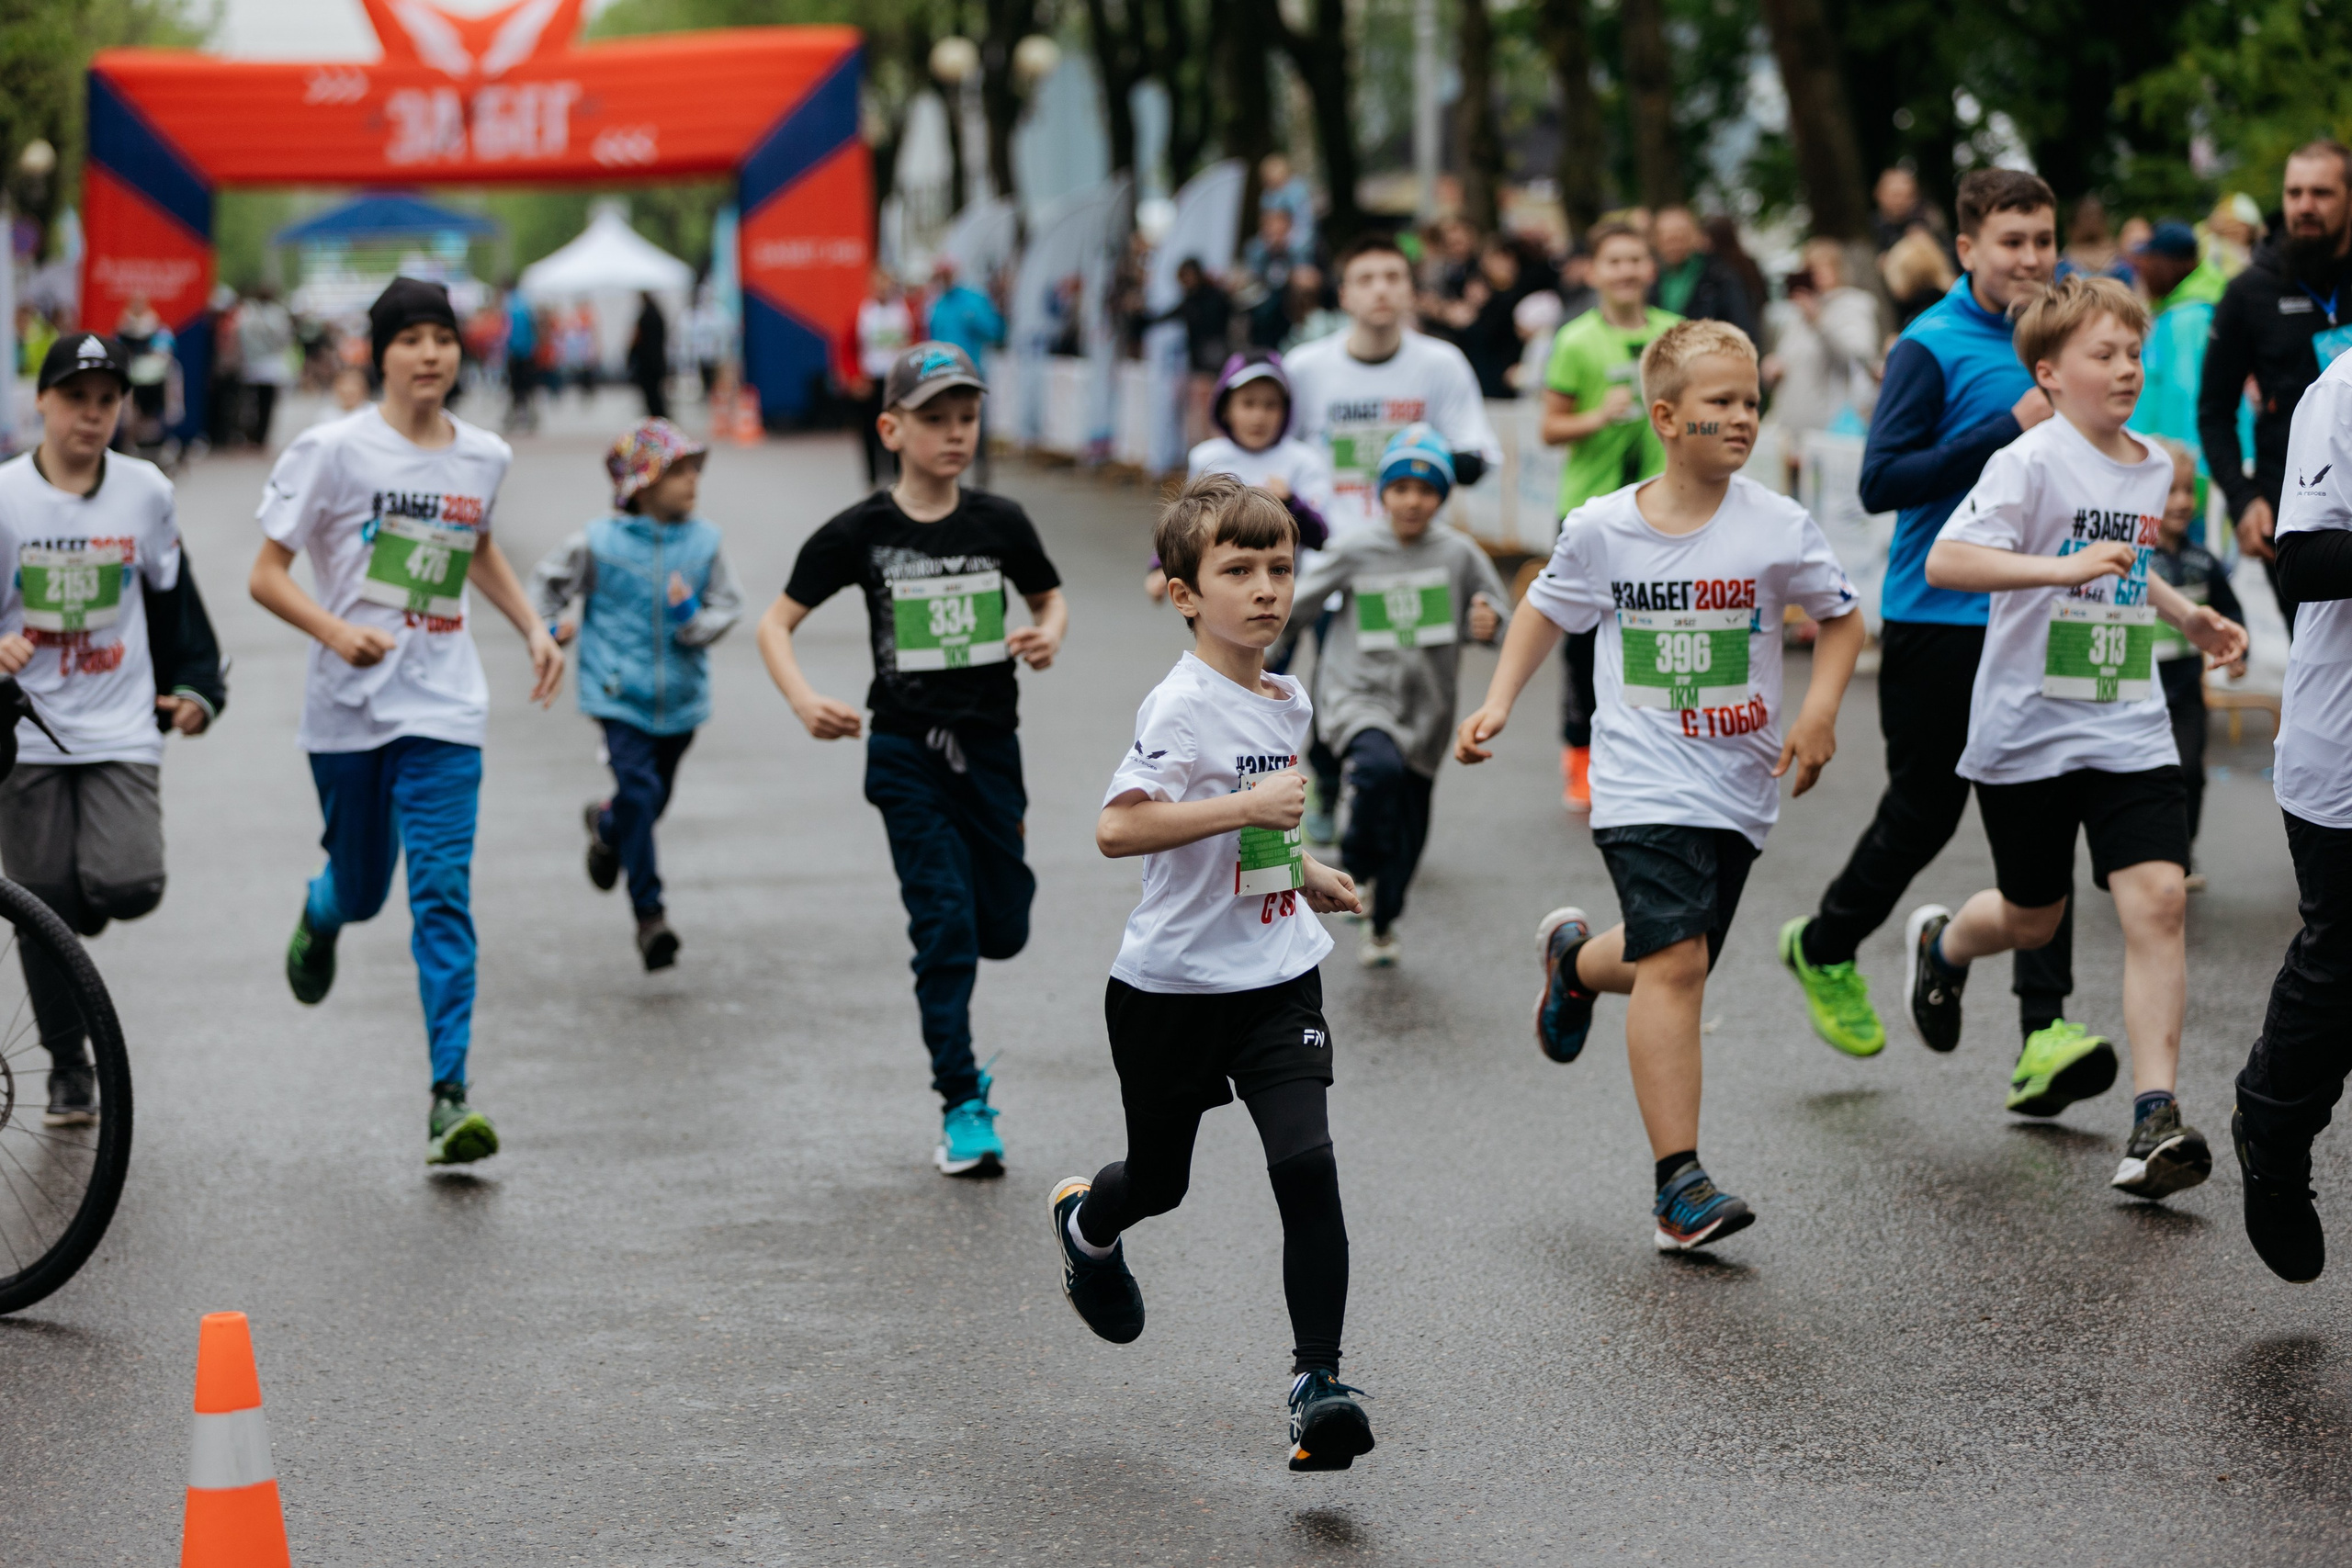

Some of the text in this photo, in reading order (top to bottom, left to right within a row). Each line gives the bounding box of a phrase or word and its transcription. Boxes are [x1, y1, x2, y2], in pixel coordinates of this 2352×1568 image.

[1611, 579, 1757, 612] #ЗАБЕГ2025
[928, 596, 977, 637] 334
[1656, 632, 1712, 675] 396
[2088, 625, 2127, 666] 313
[1680, 692, 1769, 738] С ТОБОЙ
